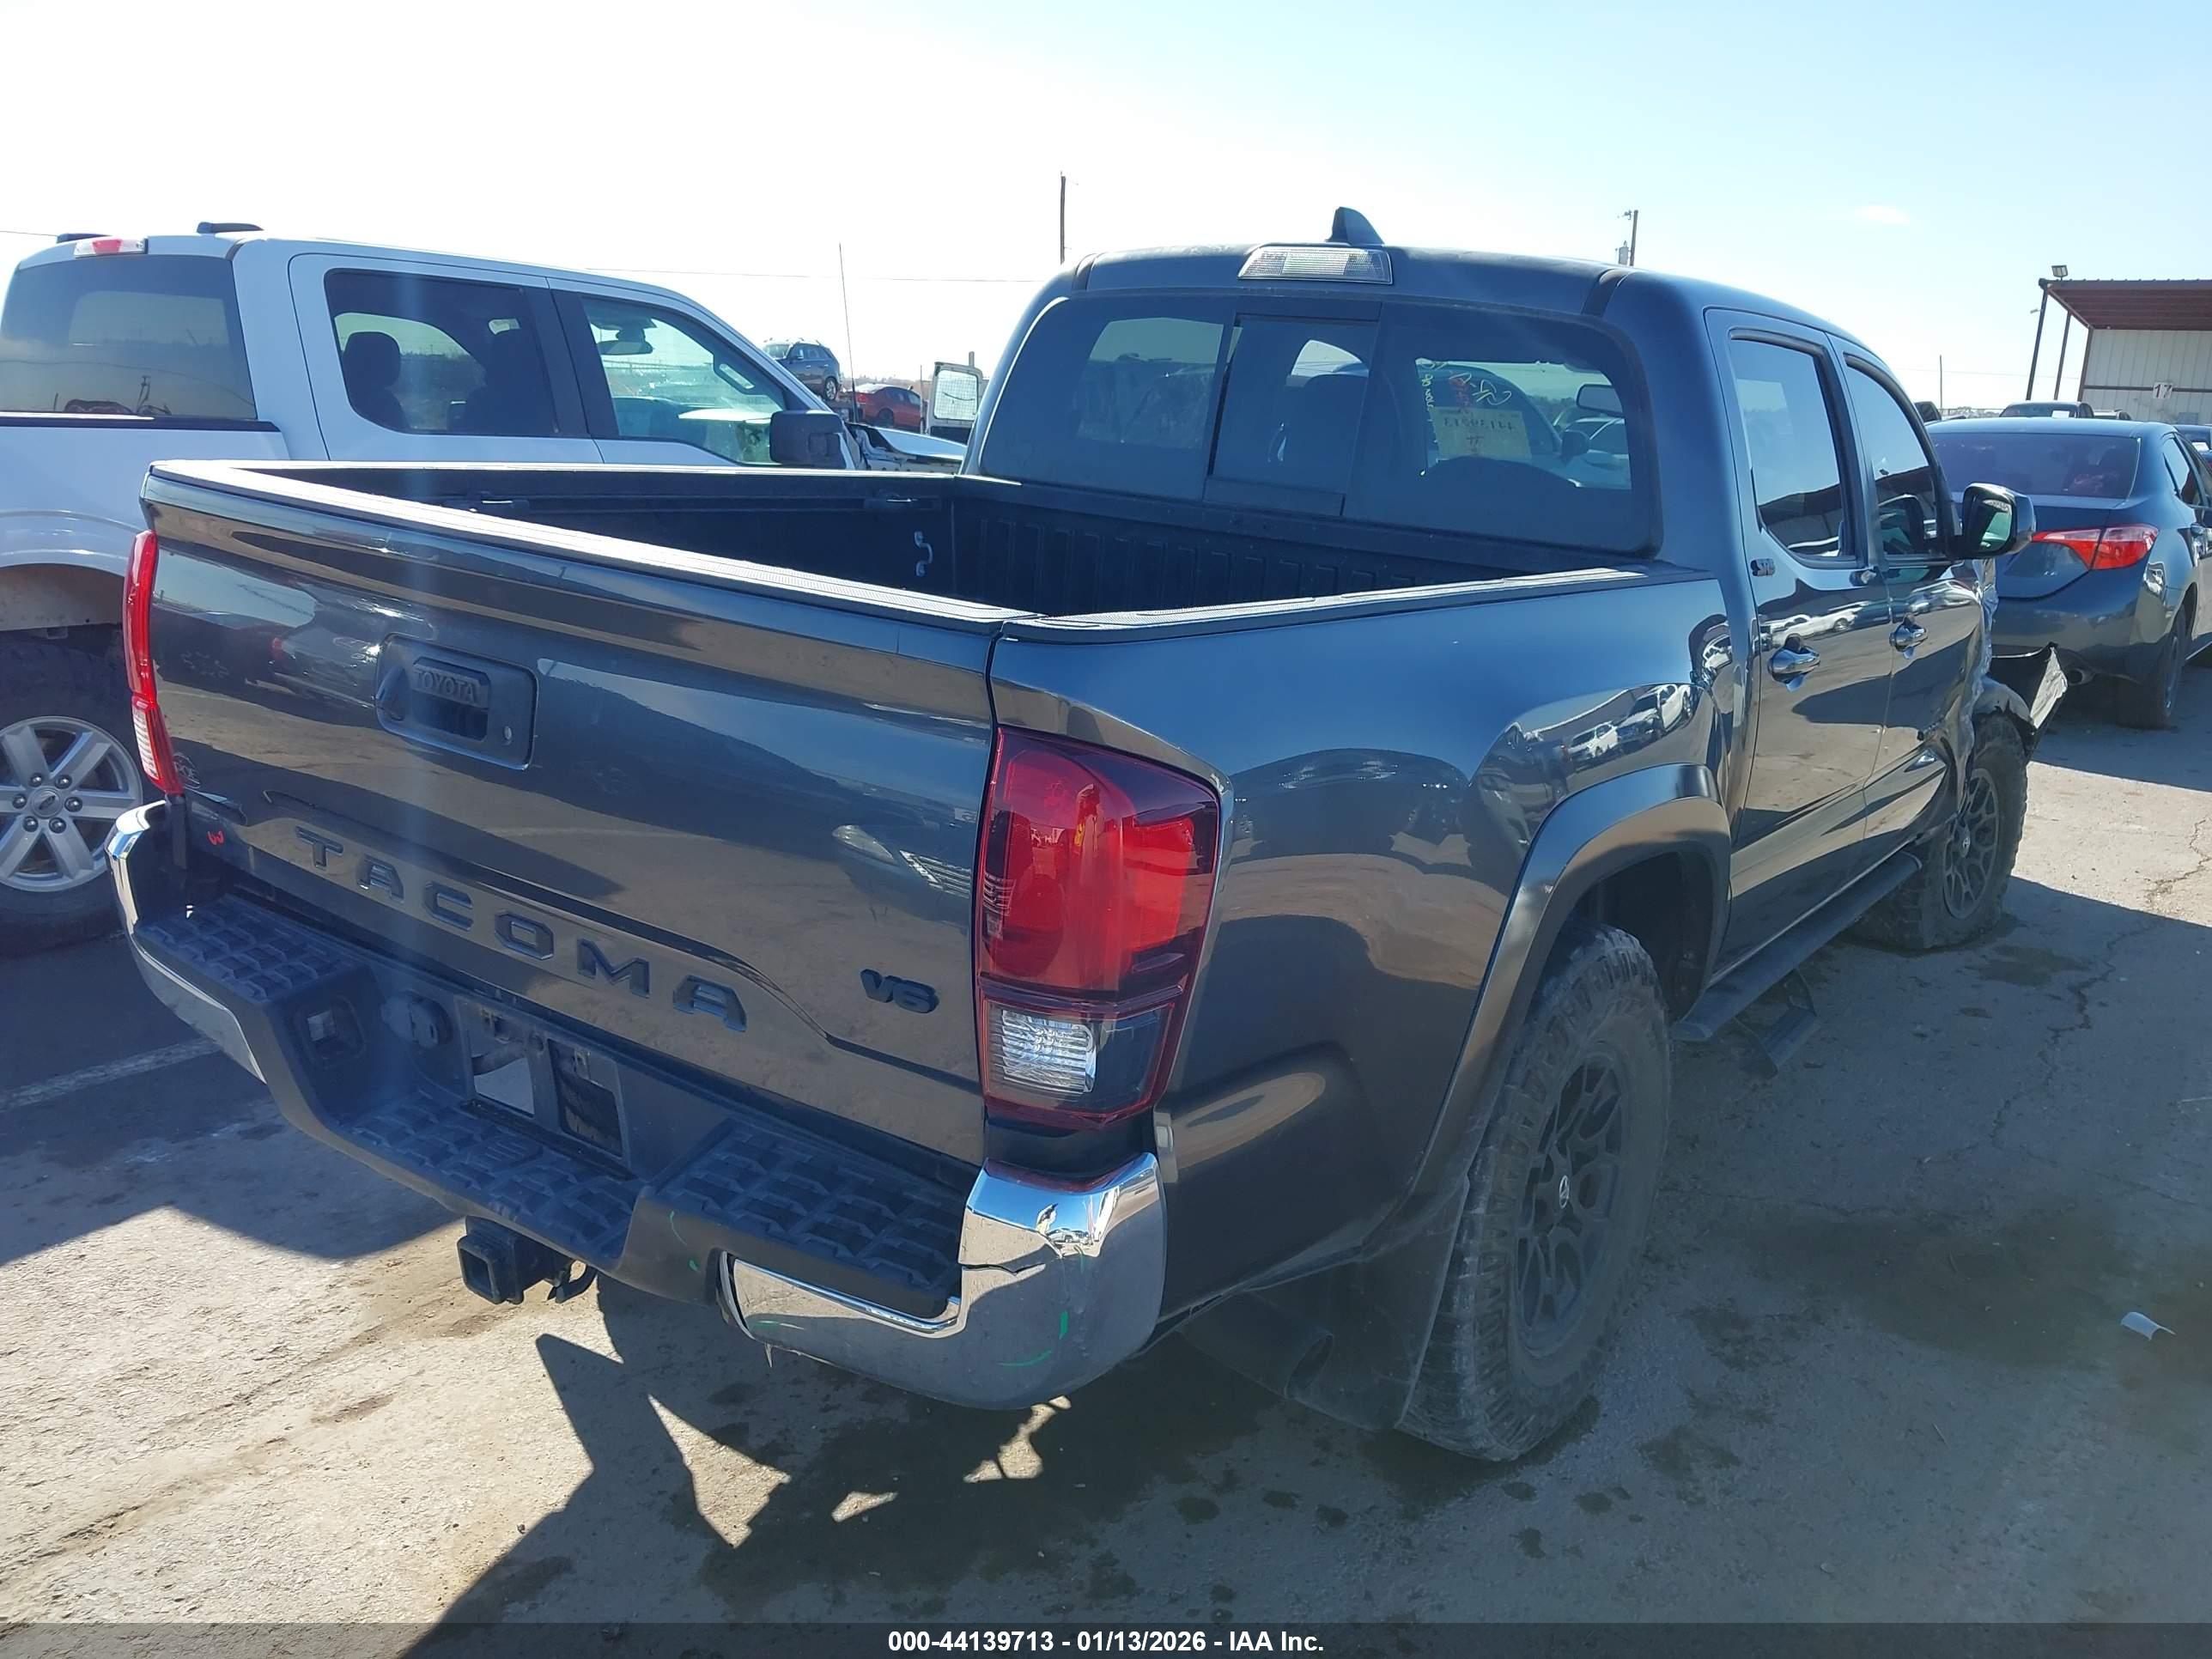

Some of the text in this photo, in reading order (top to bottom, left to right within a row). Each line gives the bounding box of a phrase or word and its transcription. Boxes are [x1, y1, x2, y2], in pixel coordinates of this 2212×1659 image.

[2154, 384, 2172, 398] 17
[413, 668, 477, 702] TOYOTA
[295, 825, 748, 1032] TACOMA
[860, 969, 939, 1013] V6
